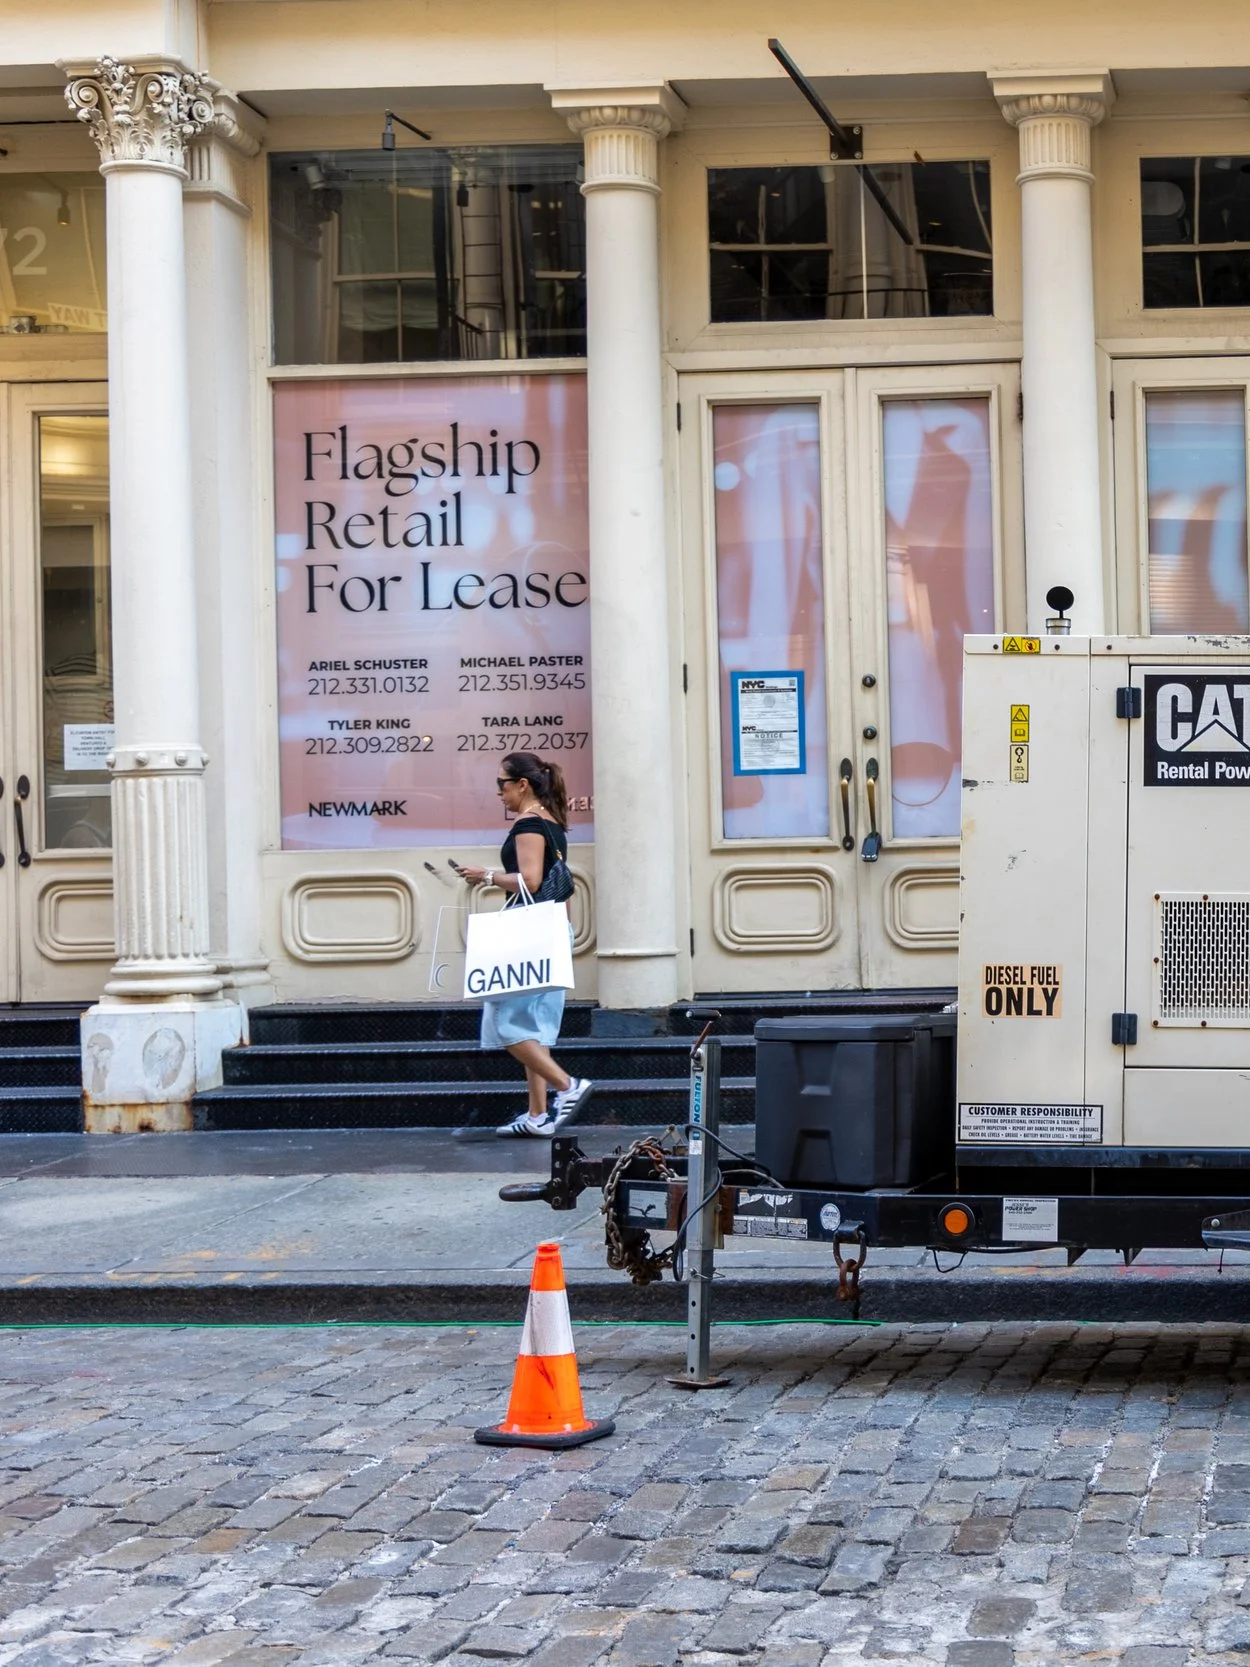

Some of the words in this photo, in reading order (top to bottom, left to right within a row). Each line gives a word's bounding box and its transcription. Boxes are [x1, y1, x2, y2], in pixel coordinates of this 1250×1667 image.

[303, 422, 541, 497] Flagship
[304, 491, 465, 550] Retail
[305, 563, 403, 613] For
[420, 561, 588, 611] Lease
[308, 659, 350, 672] ARIEL
[353, 658, 428, 671] SCHUSTER
[460, 656, 525, 668] MICHAEL
[528, 655, 584, 667] PASTER
[308, 675, 430, 696] 212.331.0132
[458, 672, 586, 692] 212.351.9345
[741, 680, 765, 689] NYC
[328, 719, 372, 731] TYLER
[376, 718, 411, 730] KING
[481, 716, 520, 728] TARA
[524, 715, 564, 727] LANG
[305, 735, 434, 755] 212.309.2822
[457, 732, 589, 752] 212.372.2037
[1157, 761, 1209, 779] Rental
[308, 800, 407, 817] NEWMARK
[467, 958, 550, 994] GANNI
[985, 965, 1027, 986] DIESEL
[1030, 965, 1060, 986] FUEL
[985, 986, 1060, 1016] ONLY
[693, 1075, 702, 1123] FULTON
[968, 1106, 1017, 1116] CUSTOMER
[1020, 1107, 1094, 1117] RESPONSIBILITY
